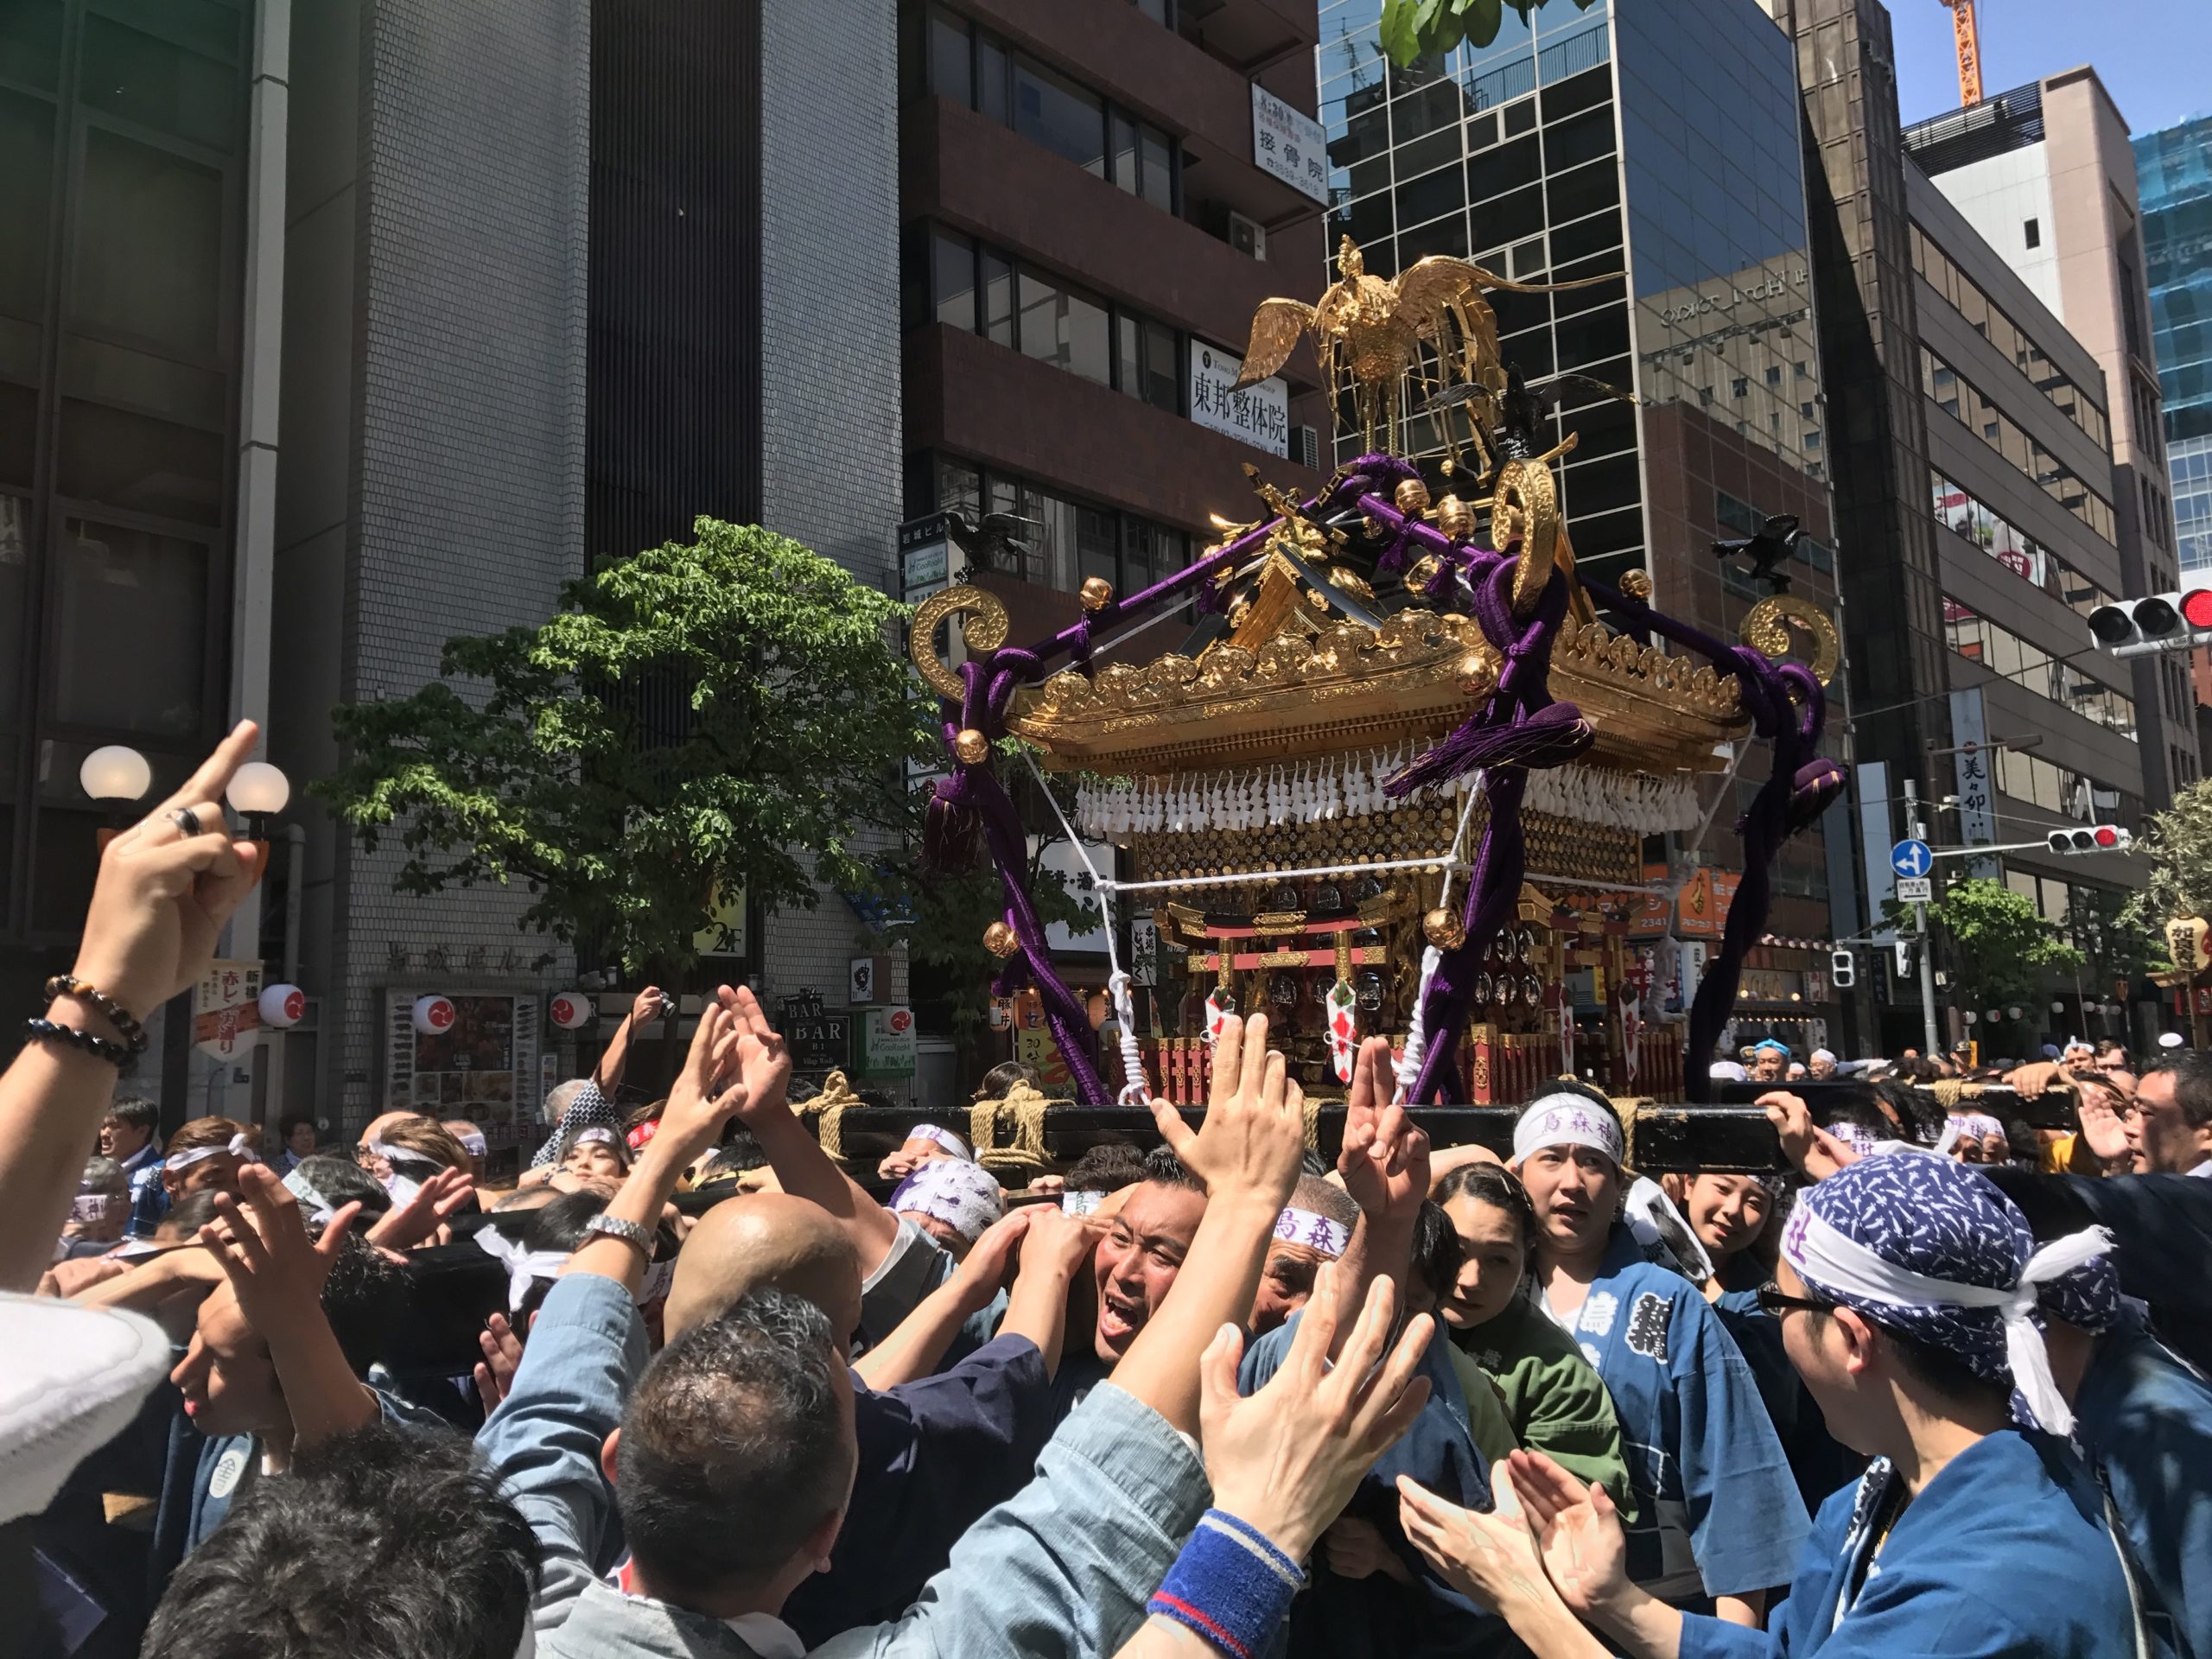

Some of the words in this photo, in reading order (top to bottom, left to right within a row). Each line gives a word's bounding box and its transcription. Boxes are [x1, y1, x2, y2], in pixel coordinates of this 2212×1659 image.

[1260, 129, 1324, 182] 接骨院
[1193, 372, 1286, 444] 東邦整体院
[902, 523, 944, 544] 岩城ビル
[1963, 757, 1986, 818] 美々卯
[713, 921, 742, 953] 2F
[788, 1002, 822, 1019] BAR
[795, 1022, 842, 1039] BAR
